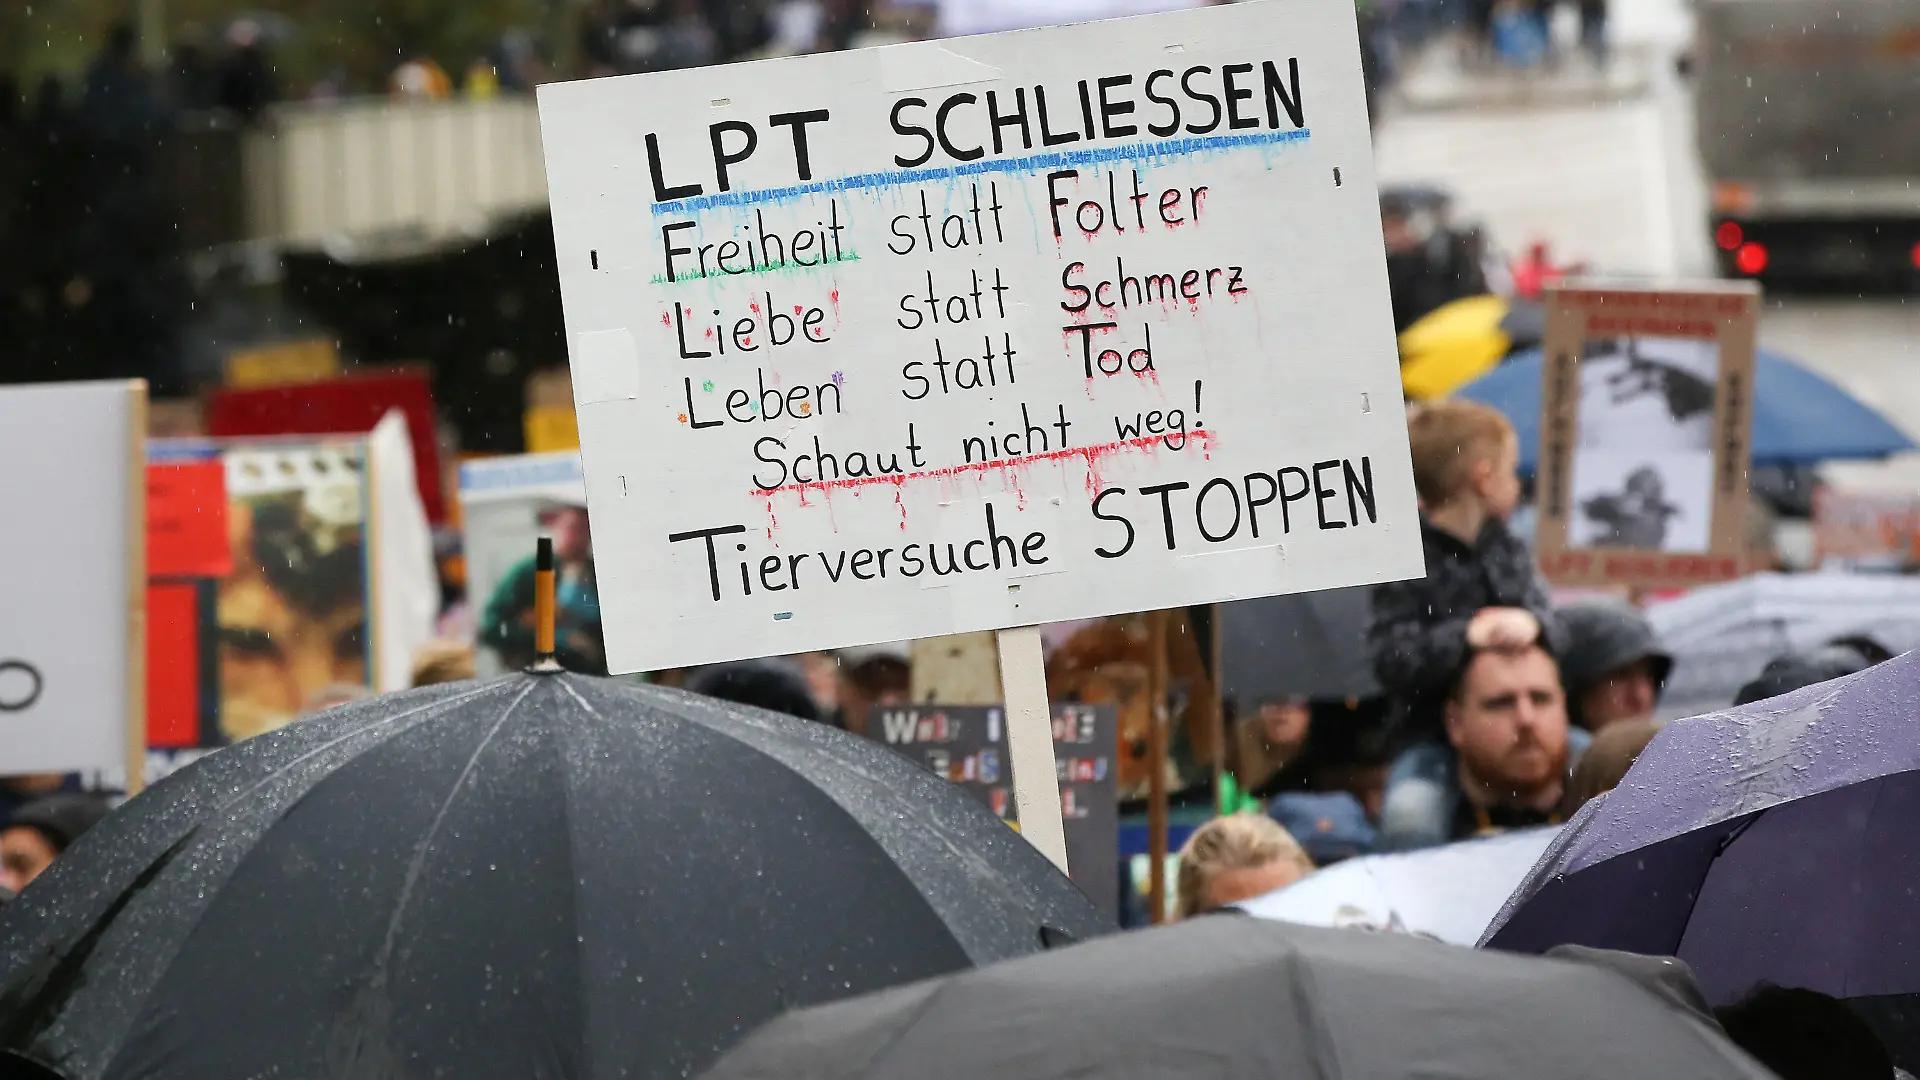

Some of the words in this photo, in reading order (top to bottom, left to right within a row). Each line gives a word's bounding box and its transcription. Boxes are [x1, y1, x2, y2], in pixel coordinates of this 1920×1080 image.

[644, 108, 830, 203] LPT
[889, 57, 1305, 169] SCHLIESSEN
[661, 198, 845, 284] Freiheit
[887, 180, 1003, 256] statt
[1046, 169, 1209, 238] Folter
[674, 290, 831, 360] Liebe
[897, 267, 1010, 330] statt
[1060, 256, 1248, 314] Schmerz
[684, 367, 841, 430] Leben
[901, 332, 1017, 400] statt
[1062, 321, 1156, 379] Tod
[752, 422, 927, 491] Schaut
[962, 402, 1072, 464] nicht
[1114, 379, 1203, 452] weg!
[668, 502, 1049, 602] Tierversuche
[1091, 456, 1377, 559] STOPPEN
